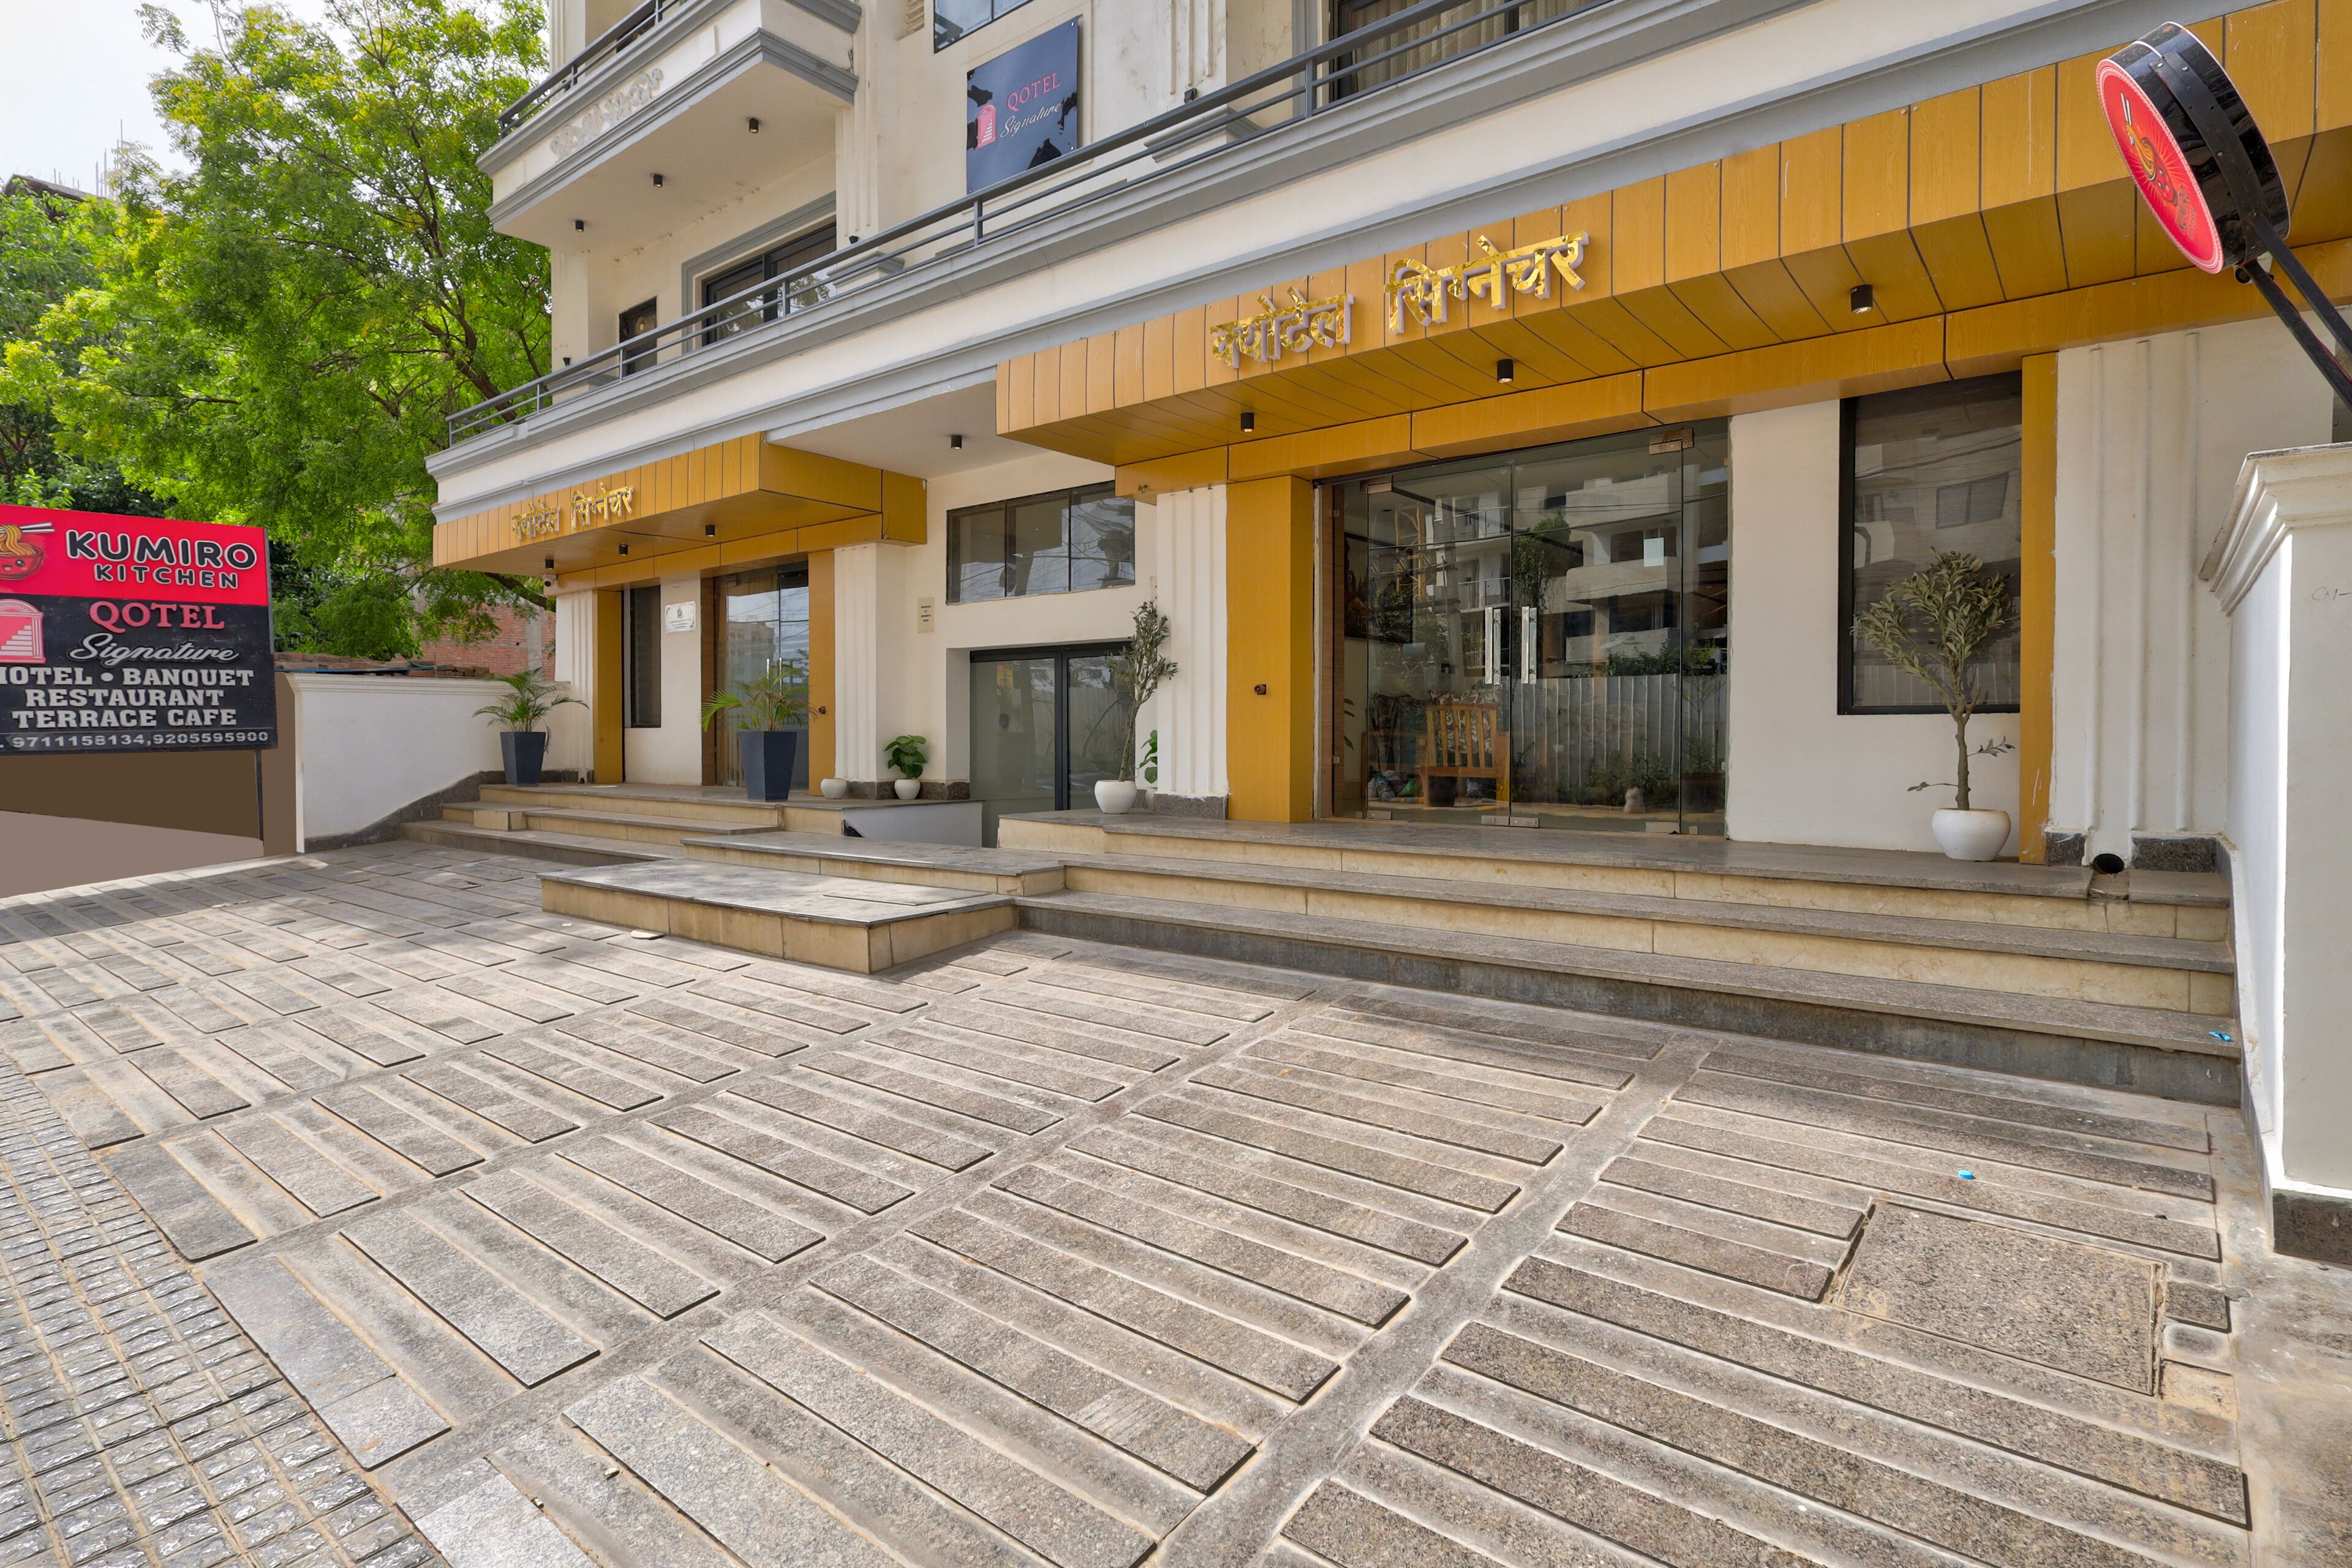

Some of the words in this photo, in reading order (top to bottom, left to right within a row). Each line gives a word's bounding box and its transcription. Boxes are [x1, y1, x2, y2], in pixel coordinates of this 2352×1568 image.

[1007, 71, 1061, 111] QOTEL
[1000, 102, 1062, 138] Signature
[1384, 230, 1589, 334] सिग्नेचर
[570, 481, 634, 529] सिग्नेचर
[66, 530, 257, 570] KUMIRO
[94, 564, 239, 589] KITCHEN
[89, 601, 225, 633] QOTEL
[69, 632, 240, 667] Signature
[123, 668, 254, 687] BANQUET
[25, 688, 224, 707] RESTAURANT
[12, 709, 157, 729] TERRACE
[167, 708, 237, 726] CAFE
